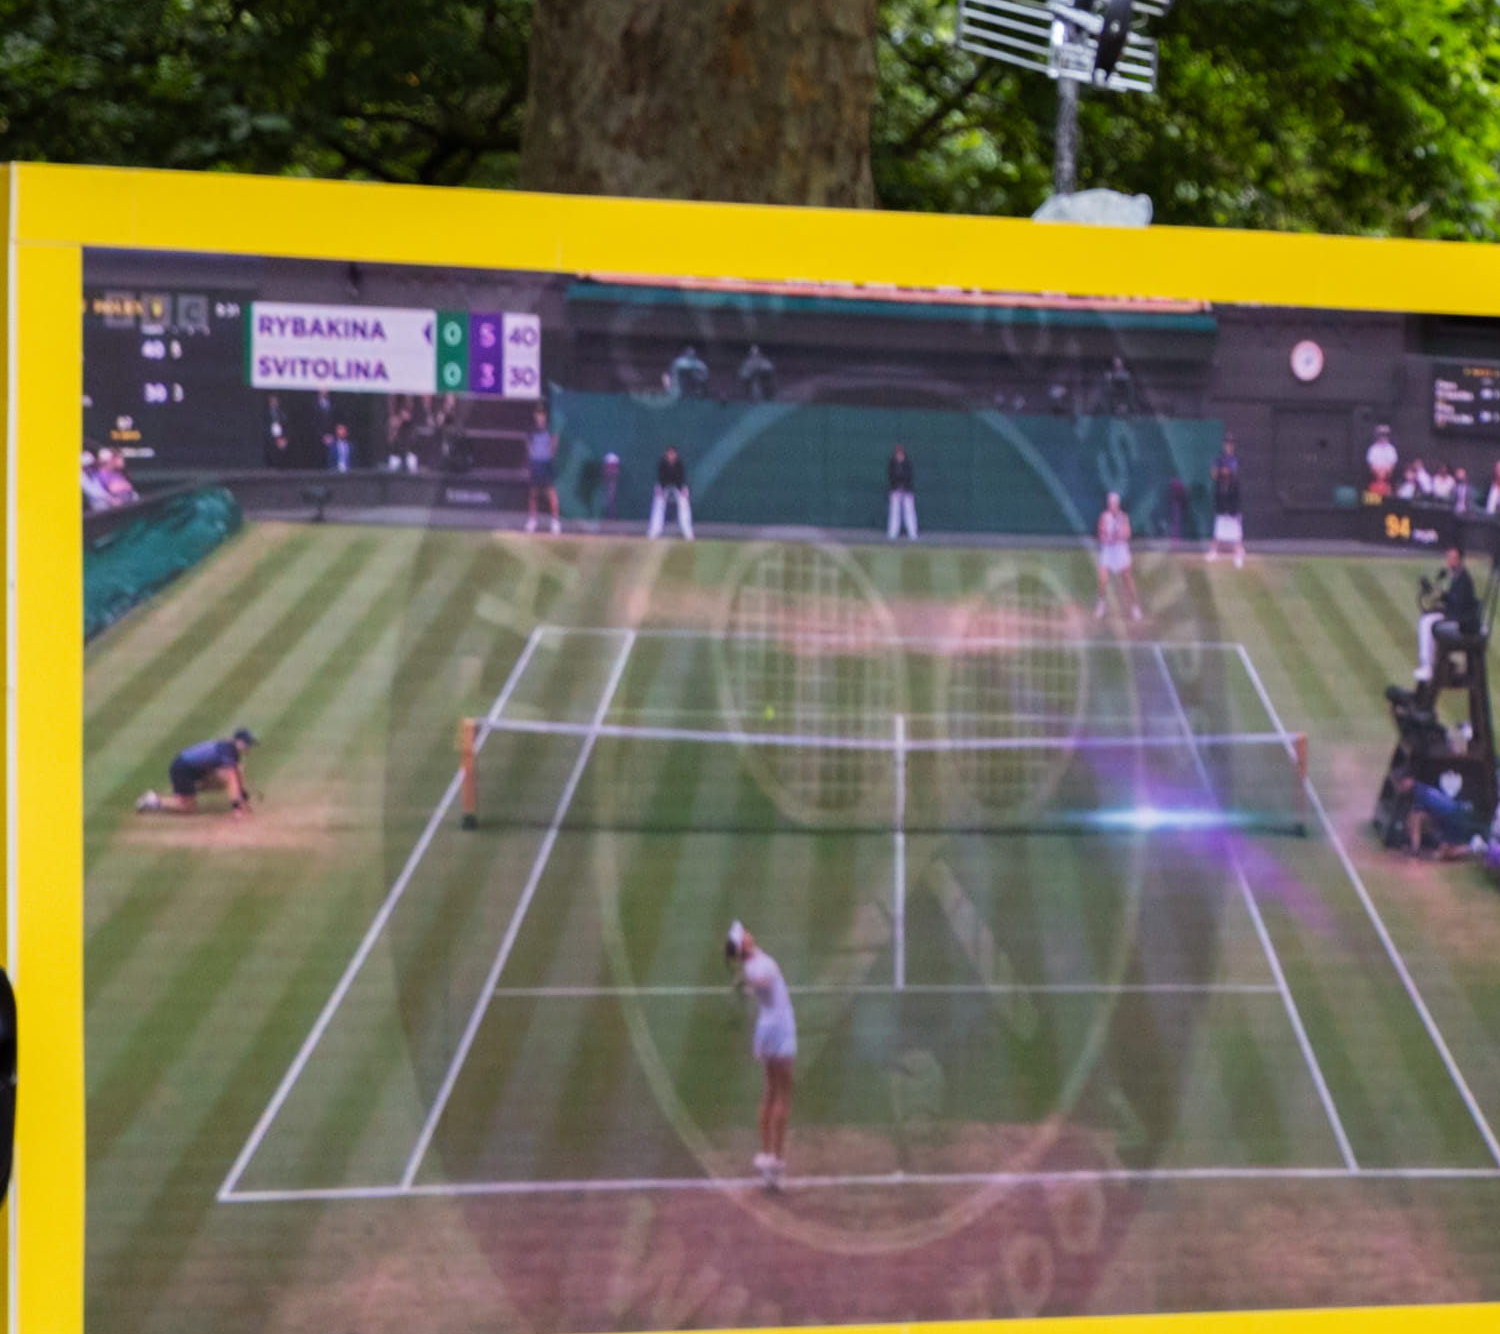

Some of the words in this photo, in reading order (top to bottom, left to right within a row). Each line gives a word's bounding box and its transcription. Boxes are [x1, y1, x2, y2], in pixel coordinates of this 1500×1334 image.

[258, 316, 386, 341] RYBAKINA
[442, 320, 462, 347] 0
[478, 322, 497, 348] 5
[508, 326, 538, 346] 40
[258, 355, 389, 381] SVITOLINA
[442, 361, 462, 387] 0
[478, 362, 496, 388] 3
[508, 367, 537, 387] 30
